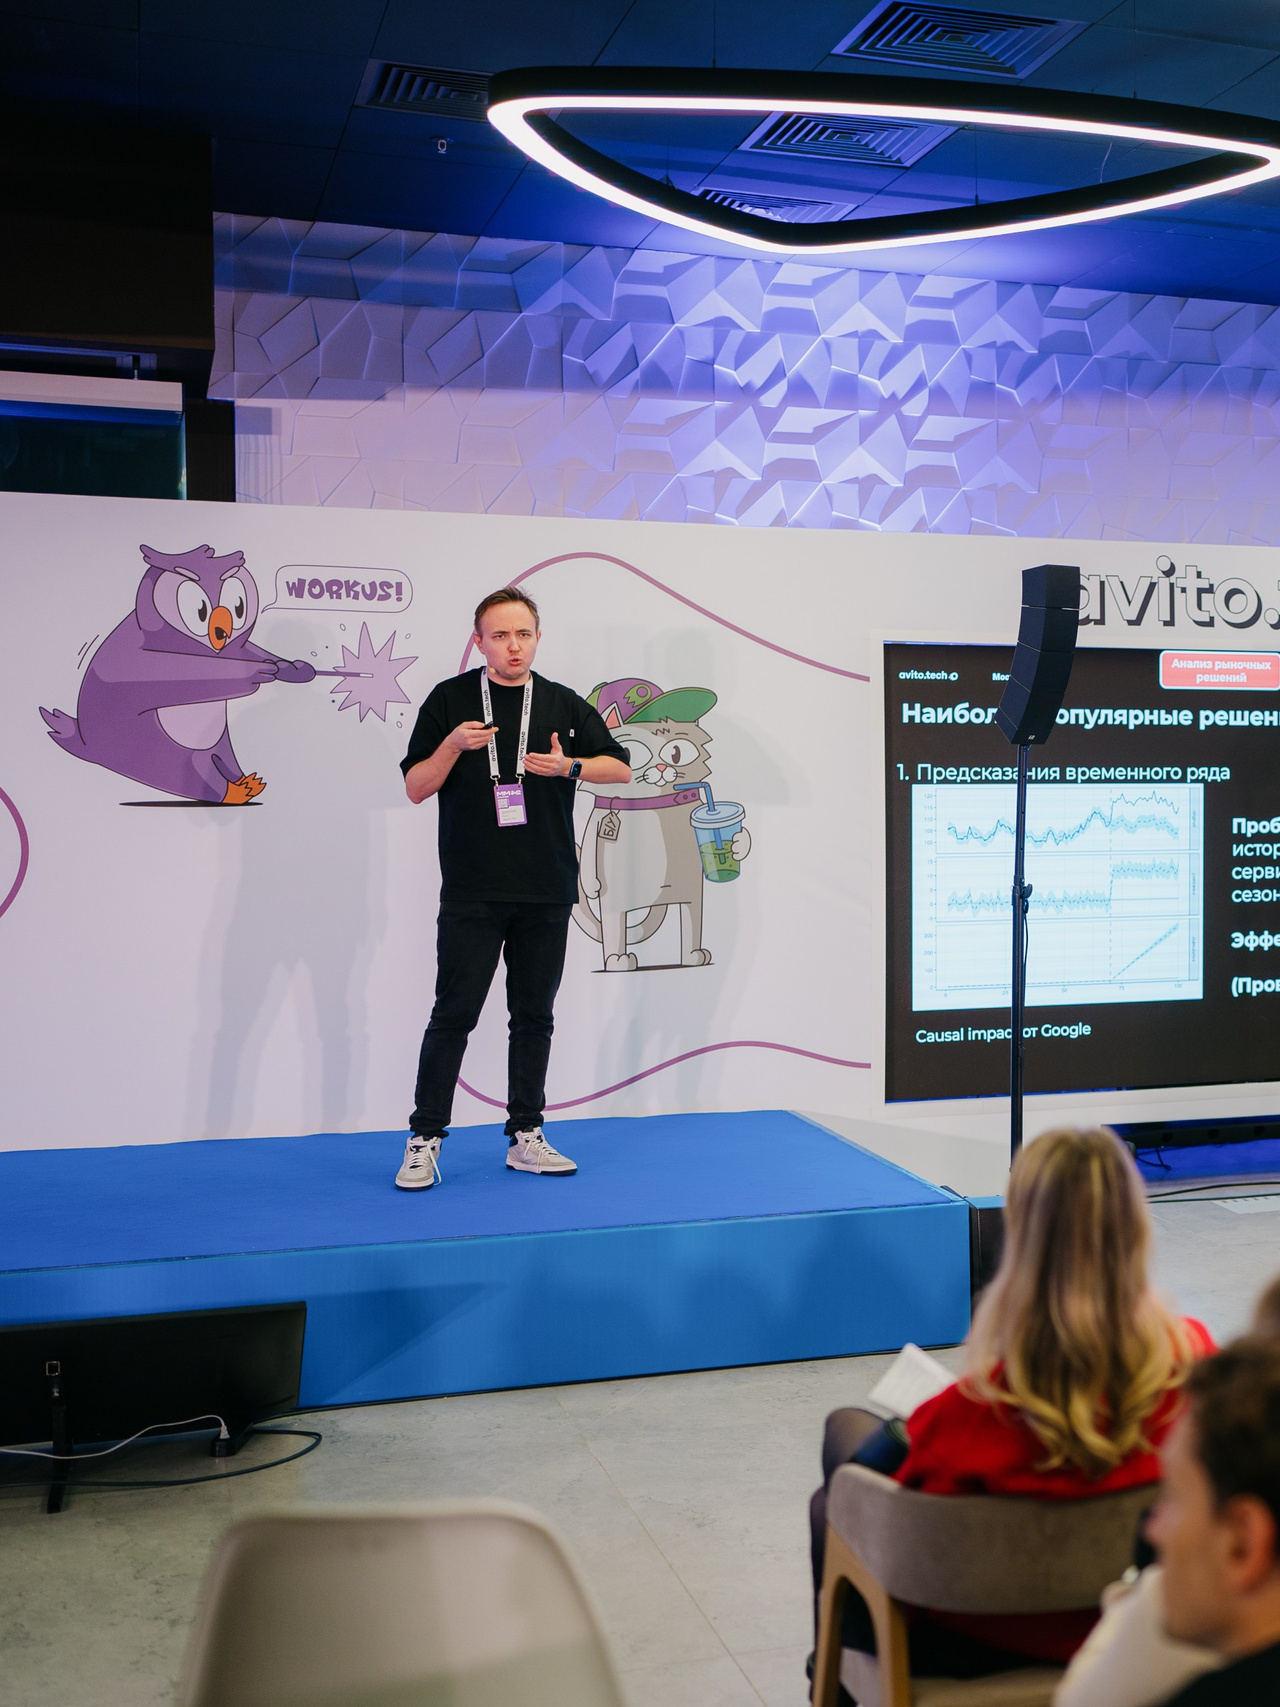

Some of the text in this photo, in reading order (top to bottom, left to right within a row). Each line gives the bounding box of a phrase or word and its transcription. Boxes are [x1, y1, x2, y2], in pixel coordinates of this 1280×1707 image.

[285, 577, 403, 602] WORKUS!
[1171, 658, 1272, 671] Анализ рыночных
[898, 669, 948, 682] avito.tech
[1195, 672, 1247, 684] решений
[902, 702, 999, 725] Наибол
[1054, 707, 1193, 731] опулярные
[896, 763, 1231, 784] 1. Предсказания временного ряда
[603, 817, 617, 837] Б/У
[915, 1021, 1092, 1044] Causal impac от Google
